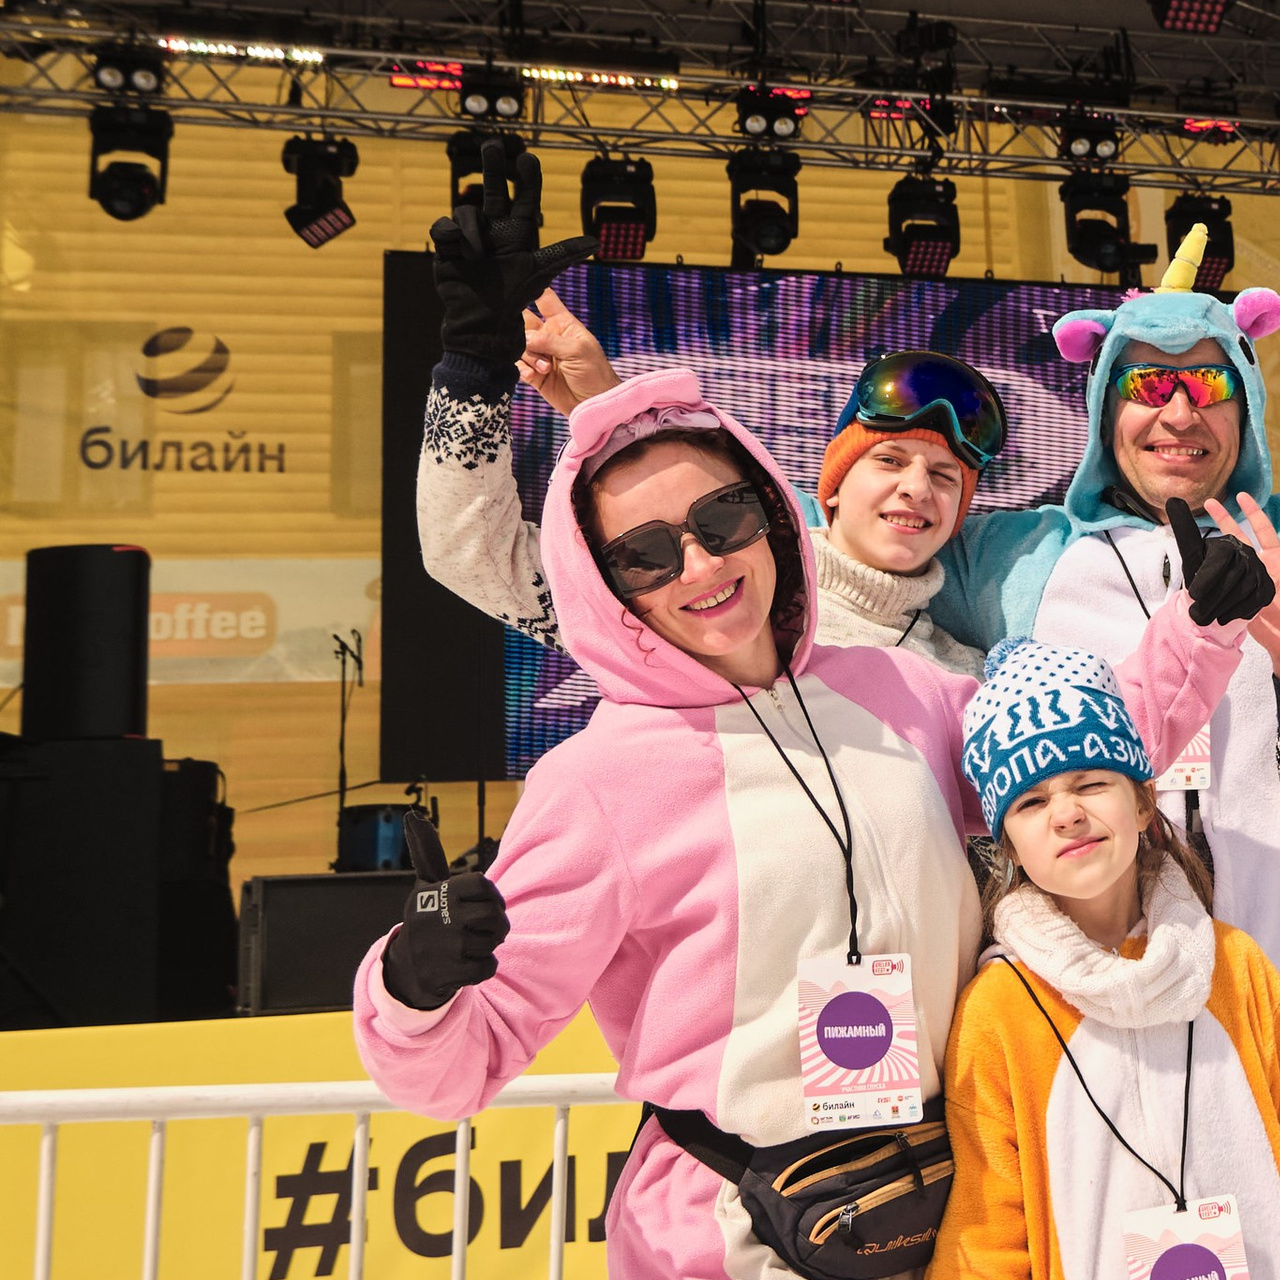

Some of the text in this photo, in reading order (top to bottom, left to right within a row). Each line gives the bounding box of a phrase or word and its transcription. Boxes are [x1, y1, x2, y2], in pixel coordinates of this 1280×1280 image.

[79, 425, 287, 475] билайн
[148, 602, 268, 642] offee
[823, 1022, 887, 1040] ПИЖАМНЫЙ
[821, 1099, 856, 1111] билайн
